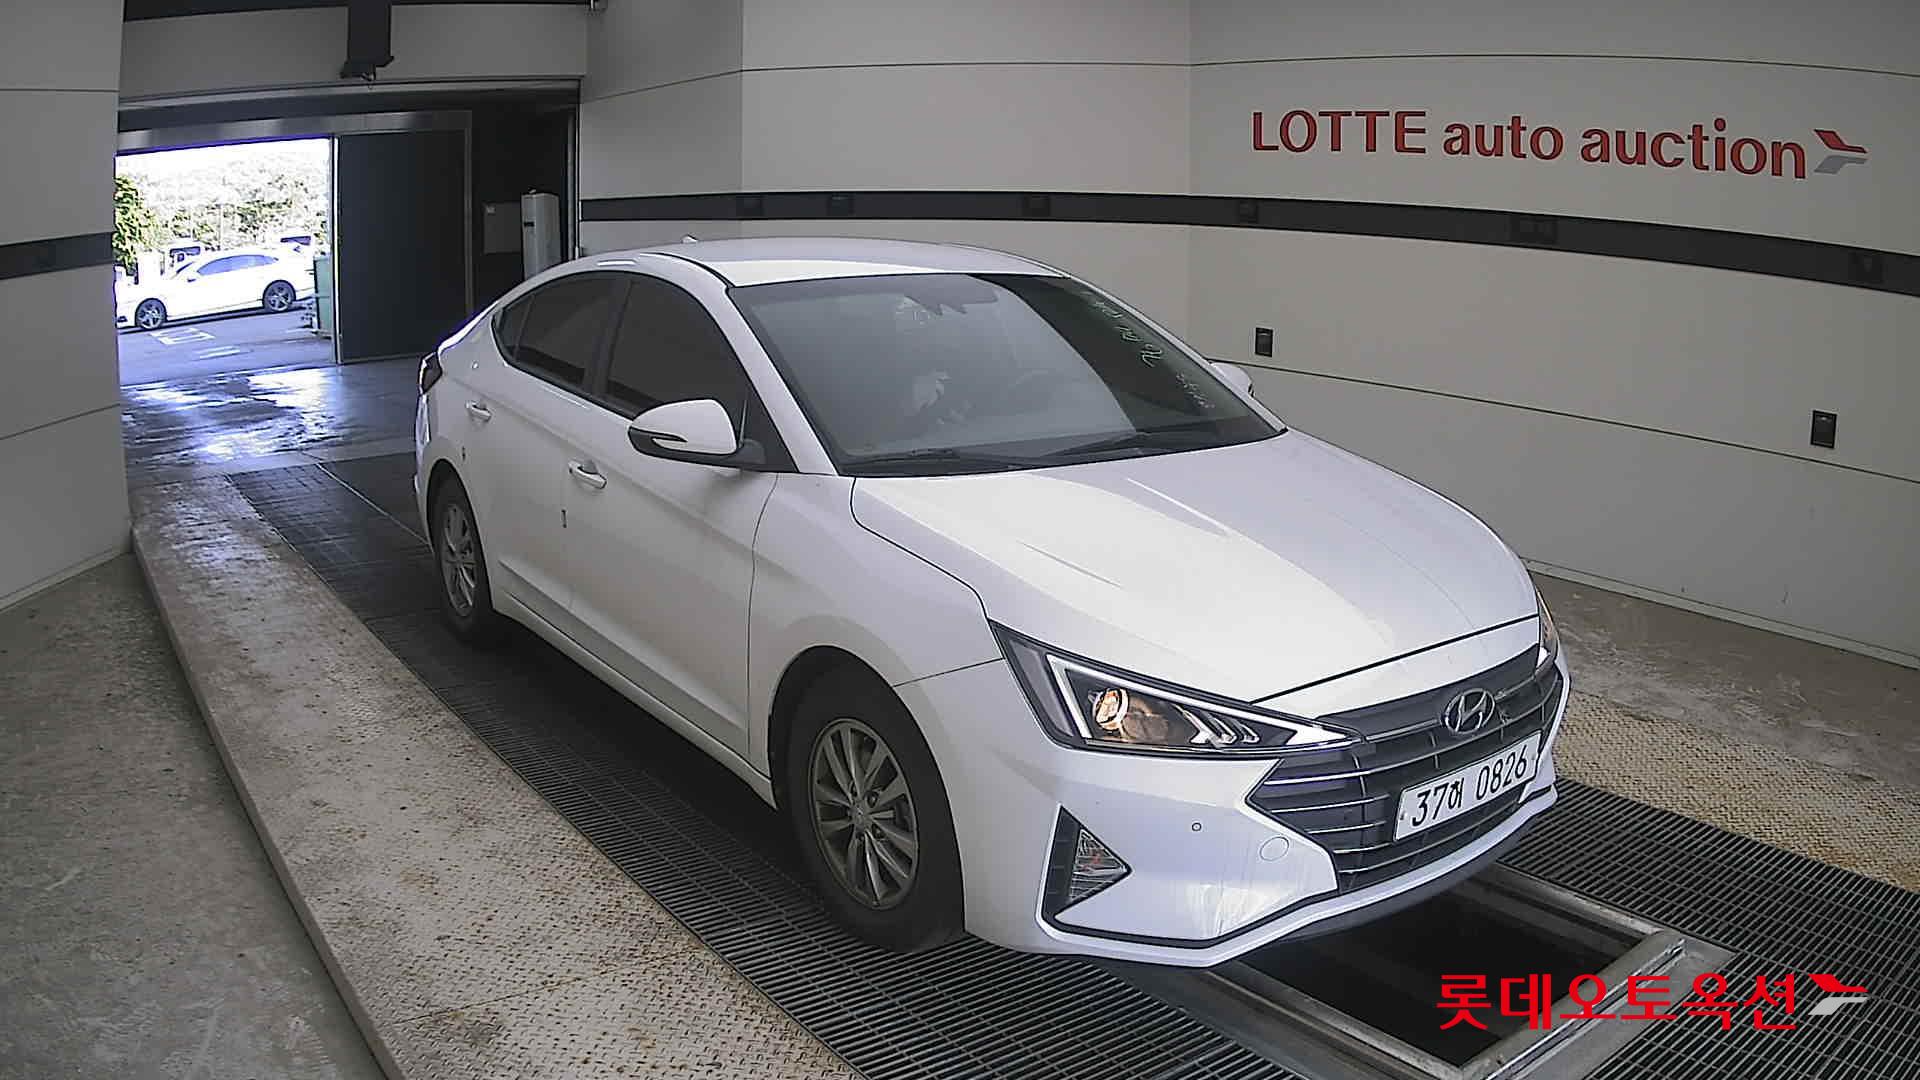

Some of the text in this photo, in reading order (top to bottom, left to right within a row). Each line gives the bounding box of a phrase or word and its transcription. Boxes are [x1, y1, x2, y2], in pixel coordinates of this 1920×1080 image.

[1252, 109, 1807, 180] LOTTE auto auction
[1476, 744, 1527, 801] 0826
